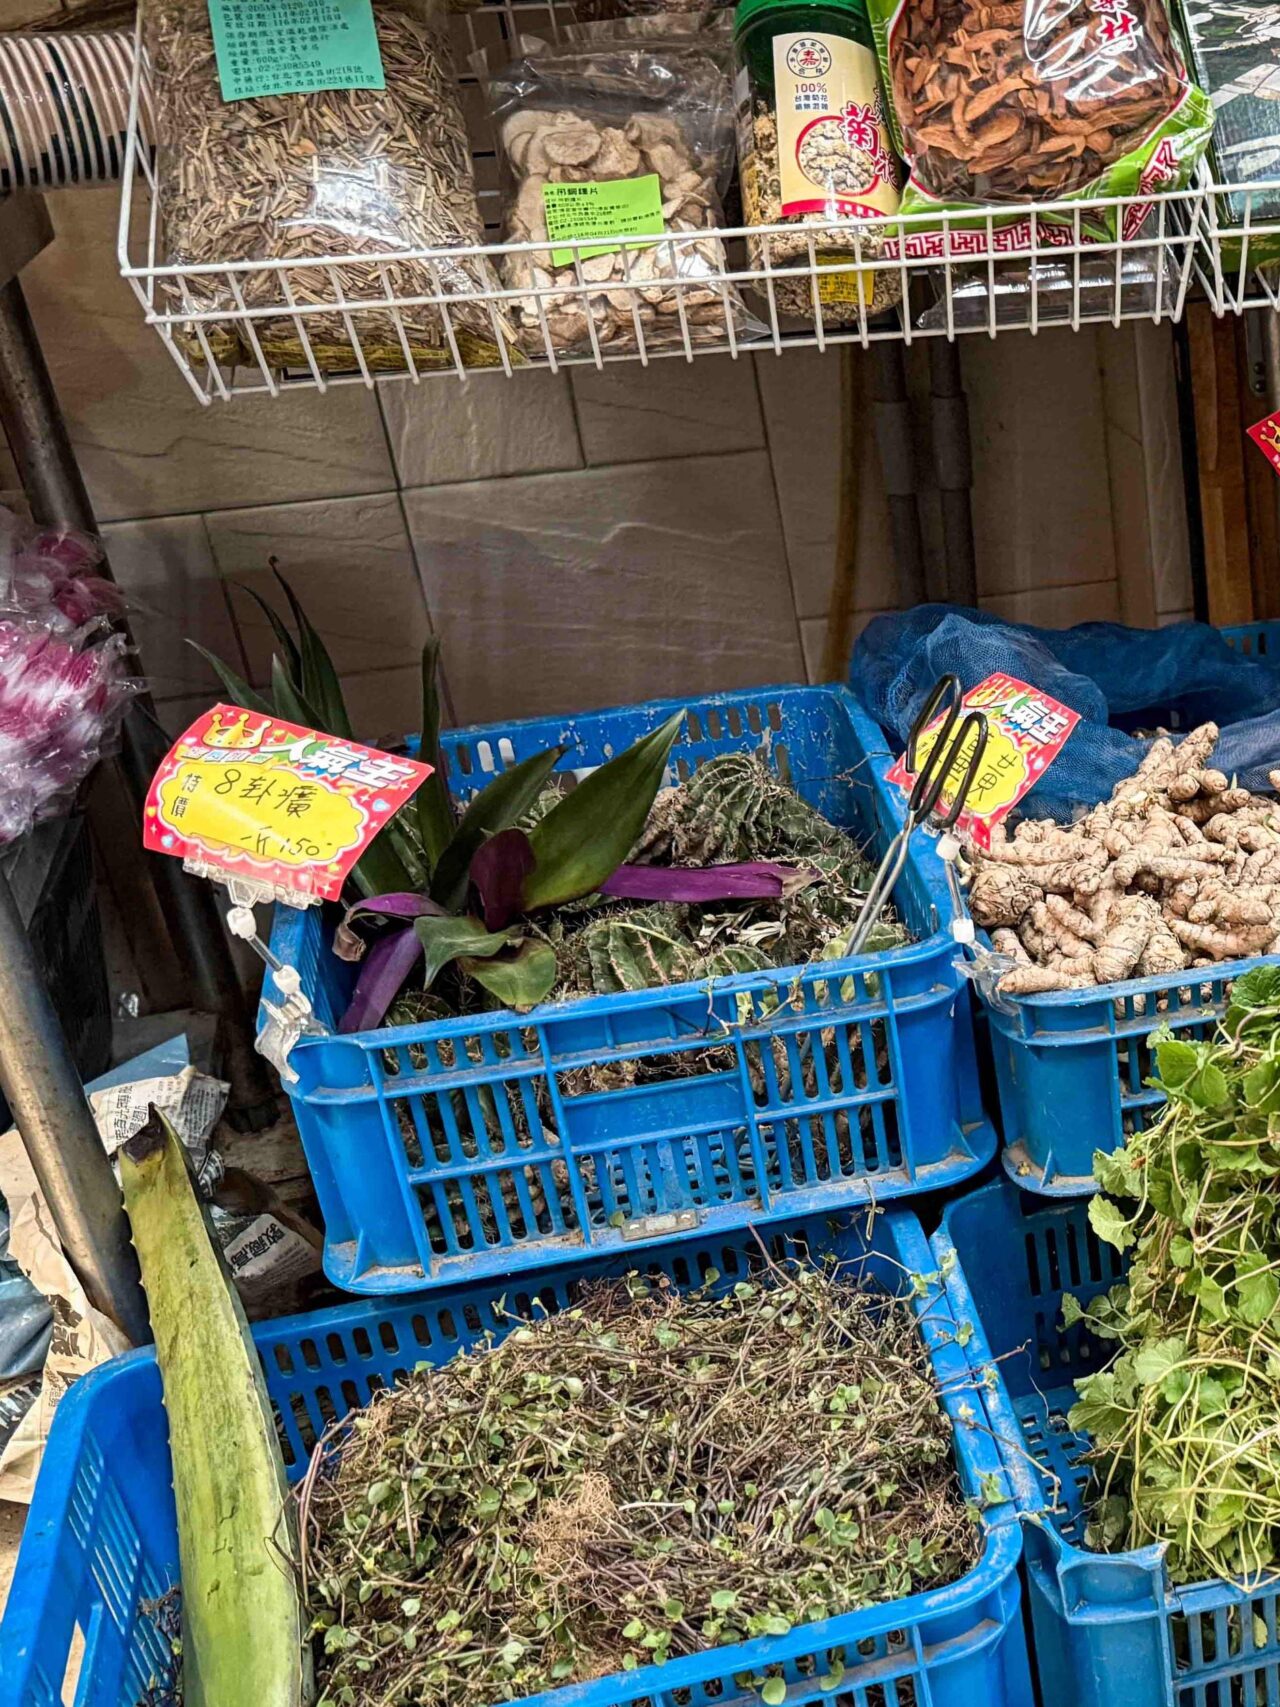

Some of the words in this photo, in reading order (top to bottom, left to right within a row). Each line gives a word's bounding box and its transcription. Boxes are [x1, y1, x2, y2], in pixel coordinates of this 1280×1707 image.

[794, 82, 828, 93] 100%
[990, 695, 1069, 744] 人氣王
[260, 738, 416, 788] 人氣王
[171, 772, 203, 818] 特價
